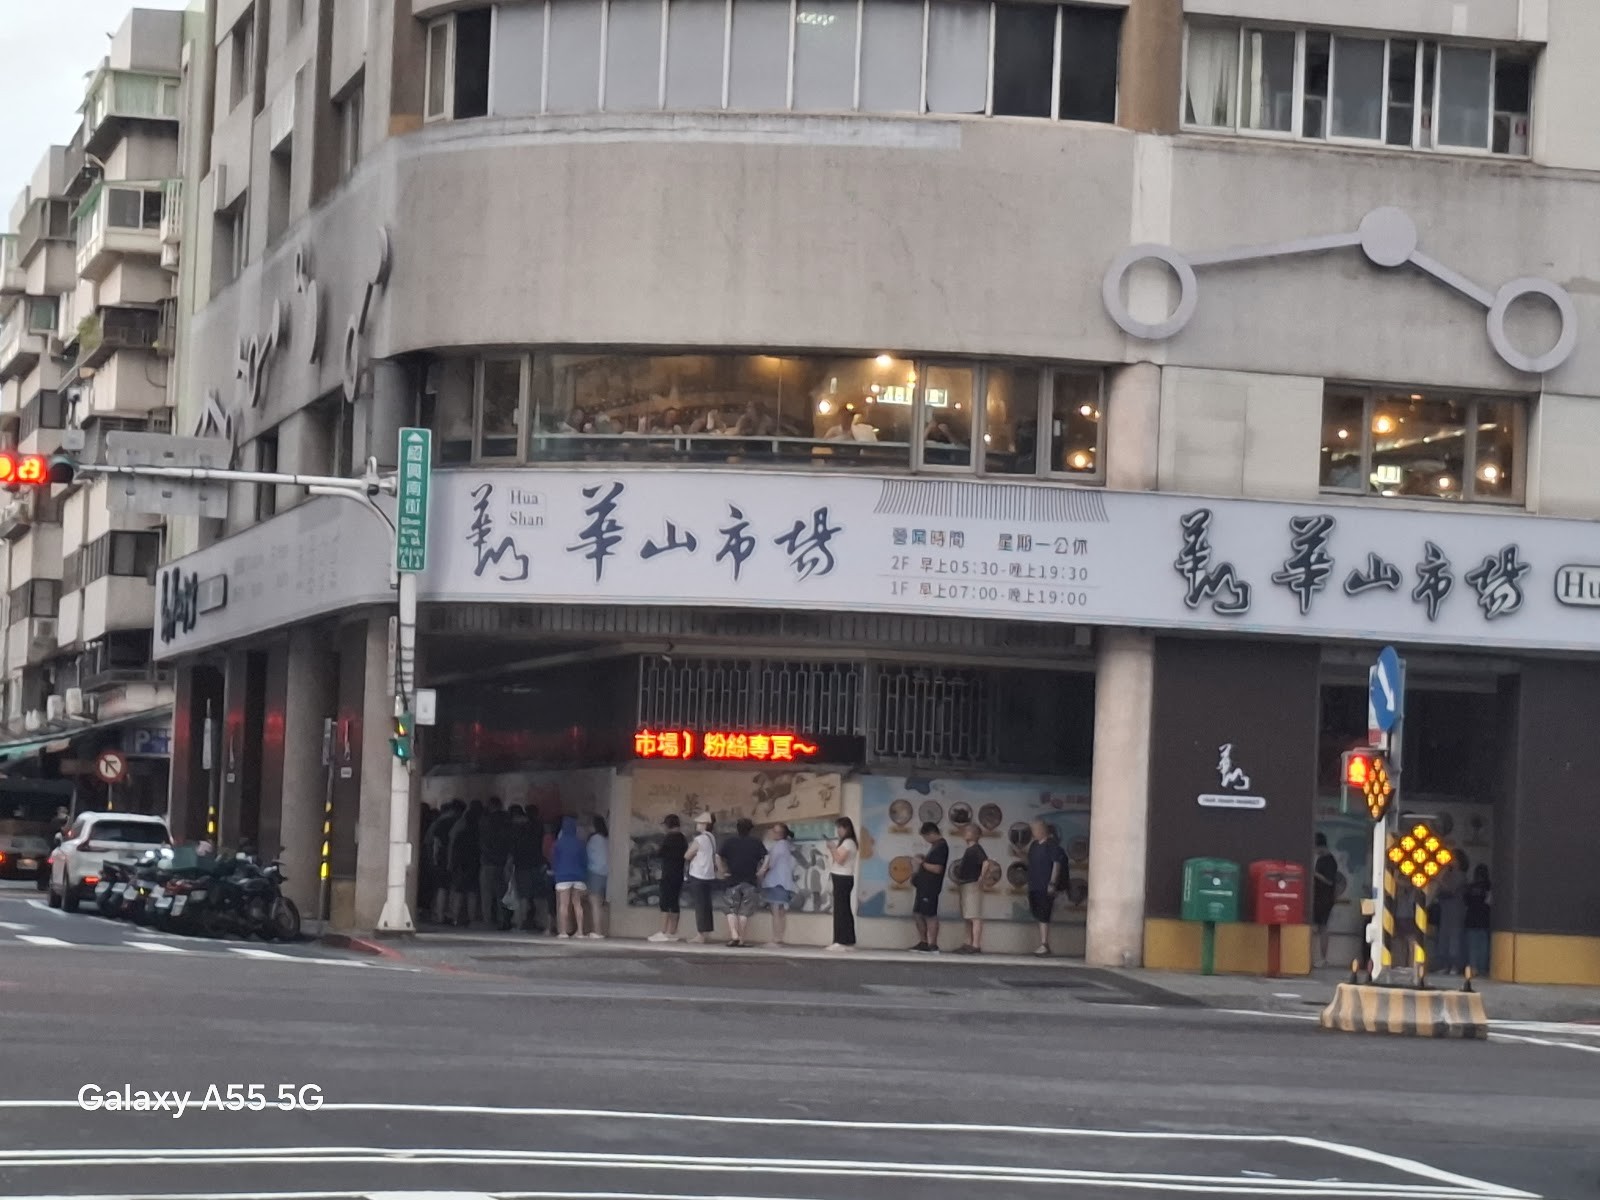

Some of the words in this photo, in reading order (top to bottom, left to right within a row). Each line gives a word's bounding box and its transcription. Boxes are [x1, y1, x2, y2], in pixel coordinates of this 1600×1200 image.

[510, 490, 539, 505] Hua
[509, 511, 544, 526] Shan
[566, 482, 841, 582] 華山市場
[890, 555, 910, 571] 2F
[1272, 513, 1531, 622] 華山市場
[890, 581, 909, 596] 1F
